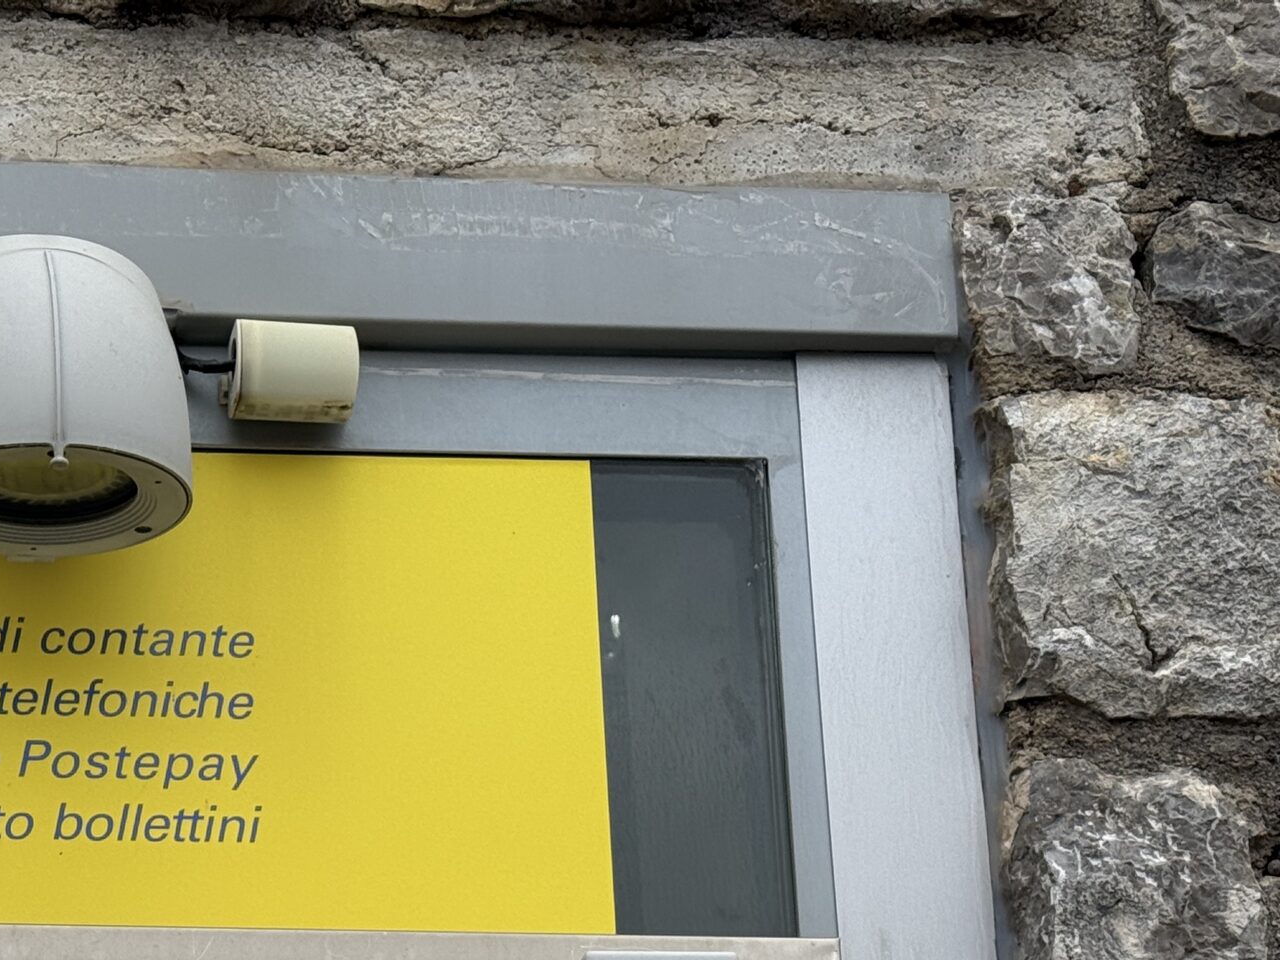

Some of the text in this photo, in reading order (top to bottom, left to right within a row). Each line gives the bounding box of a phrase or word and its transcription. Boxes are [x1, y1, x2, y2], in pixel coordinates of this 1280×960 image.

[40, 623, 255, 659] contante
[19, 740, 258, 789] Postepay
[54, 803, 262, 843] bollettini
